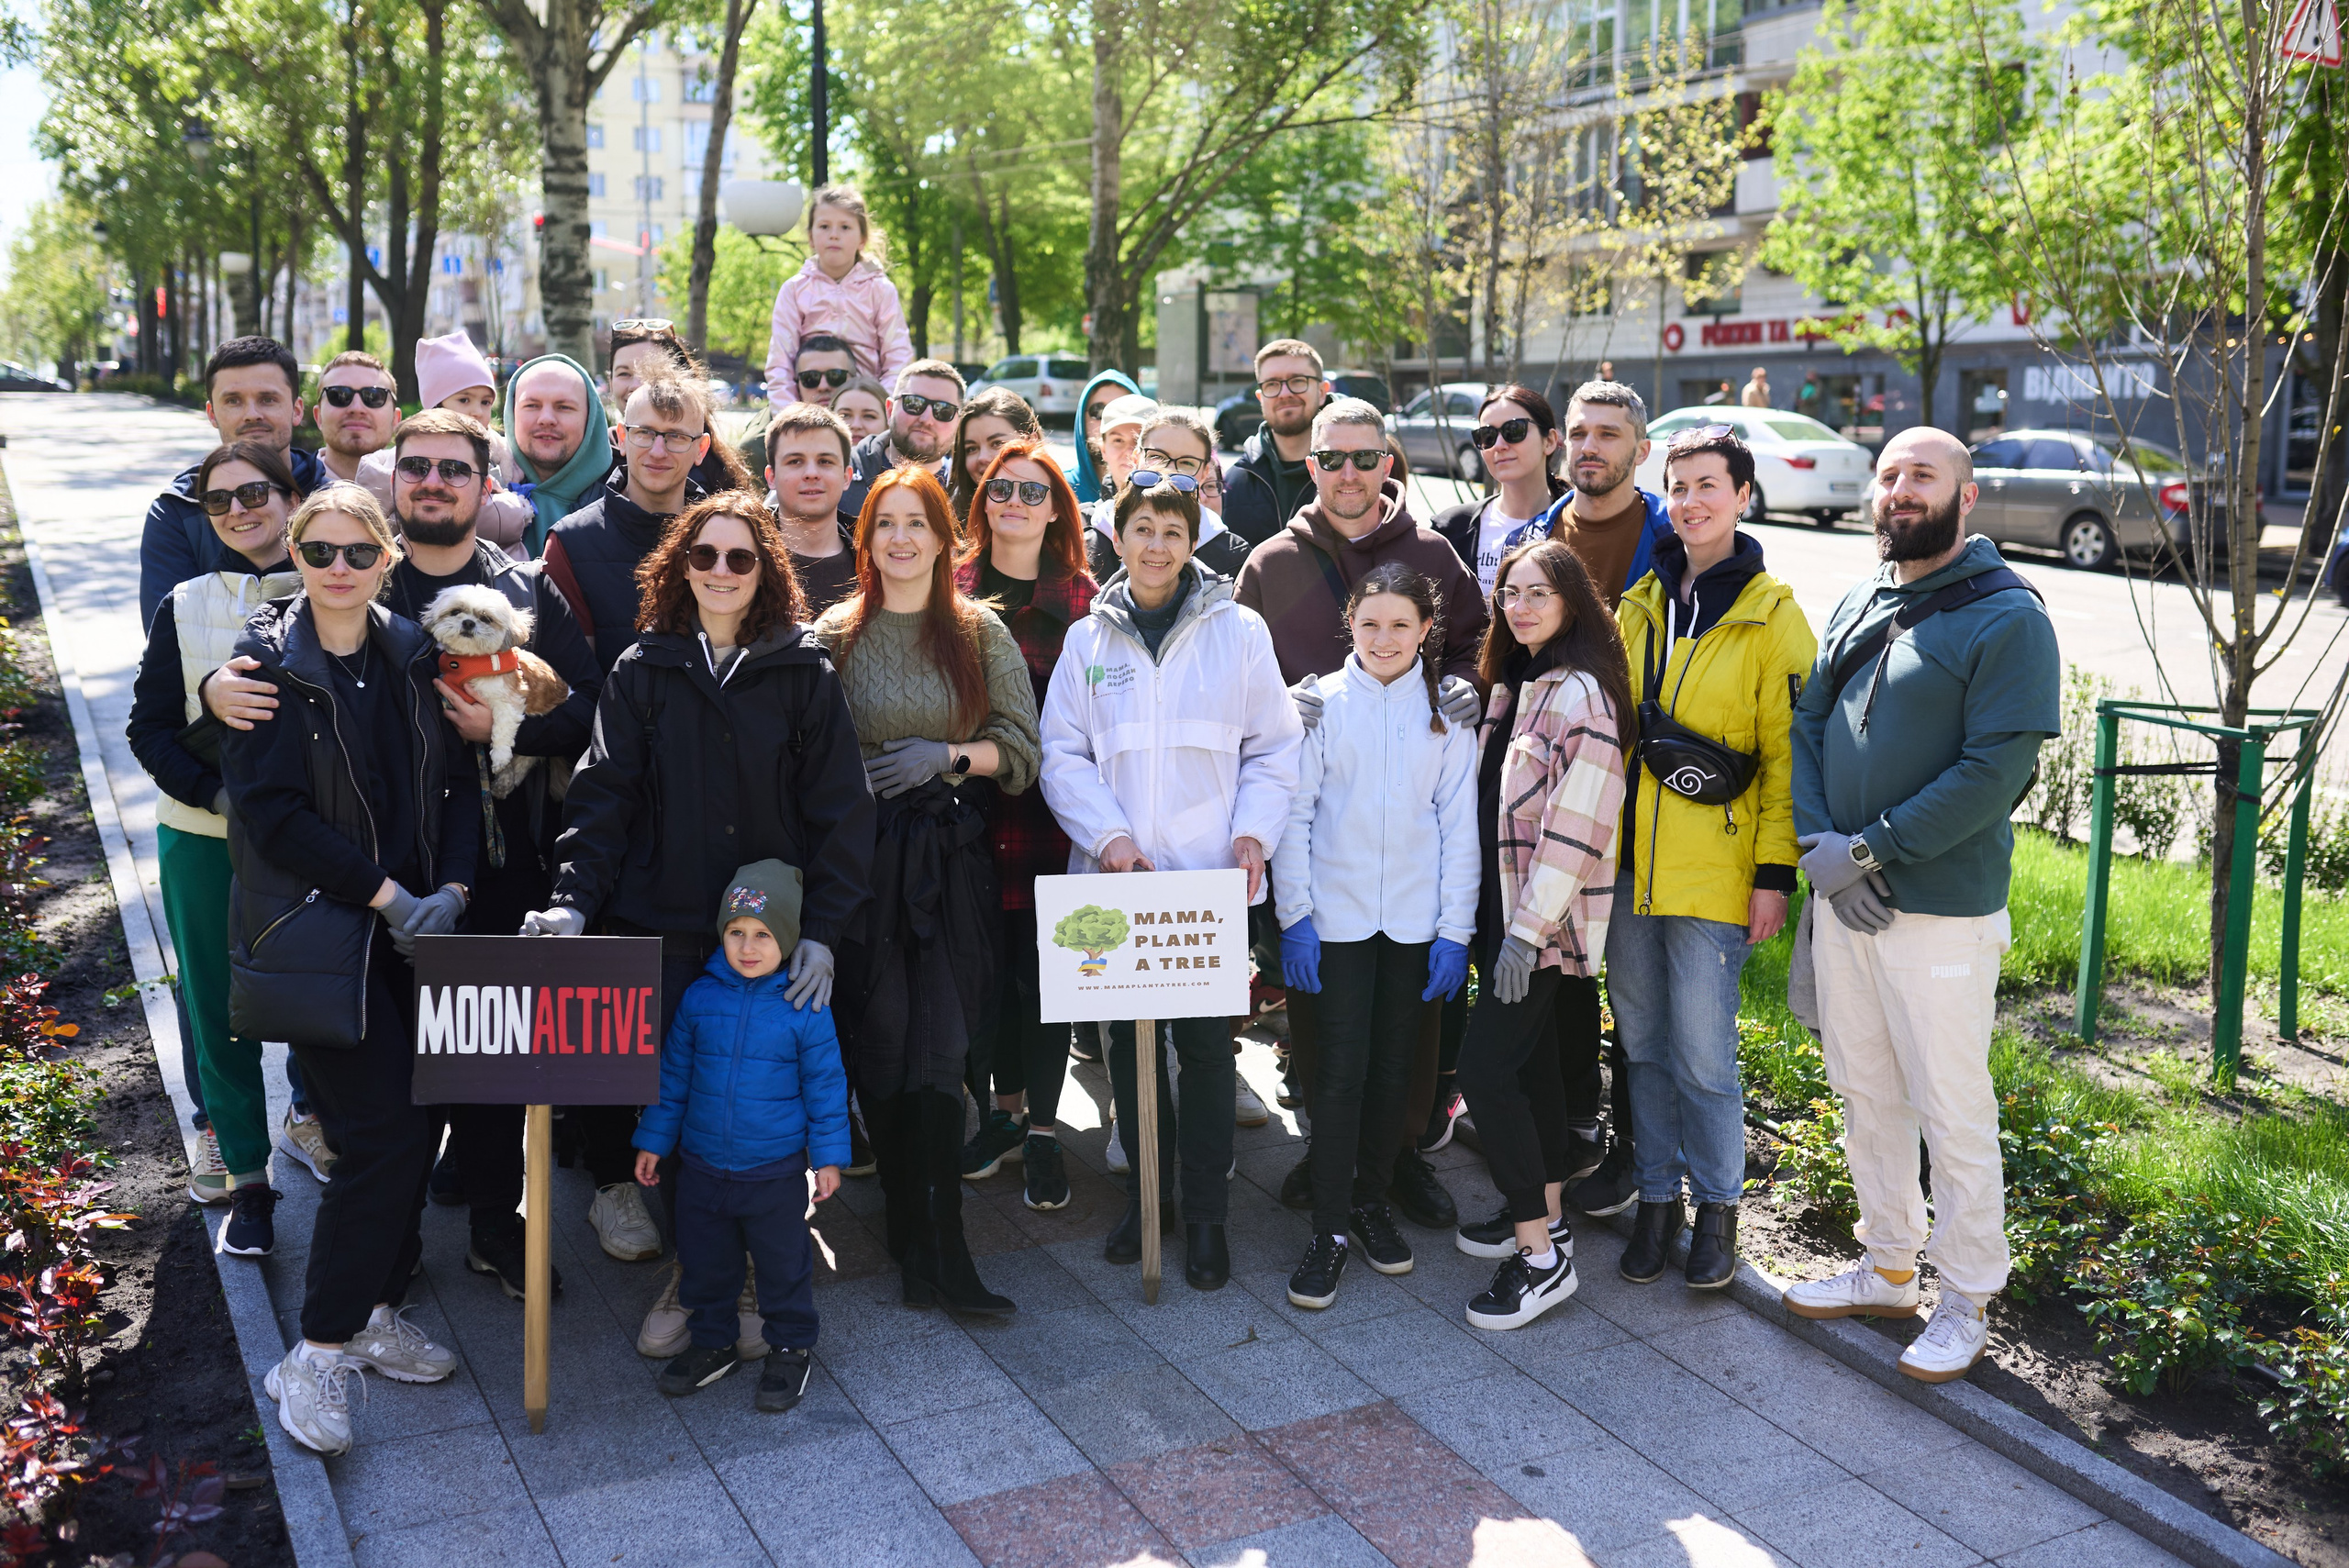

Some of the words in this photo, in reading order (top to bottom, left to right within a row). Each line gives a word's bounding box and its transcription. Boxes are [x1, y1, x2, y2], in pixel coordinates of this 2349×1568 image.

[1107, 668, 1137, 679] ПОСАДИ
[1134, 909, 1225, 925] MAMA,
[1135, 932, 1217, 948] PLANT
[1135, 958, 1151, 971] A
[1159, 955, 1221, 970] TREE
[1931, 962, 1971, 978] PUMA
[1077, 981, 1210, 991] WWW.MAMAPLANTATREE.COM
